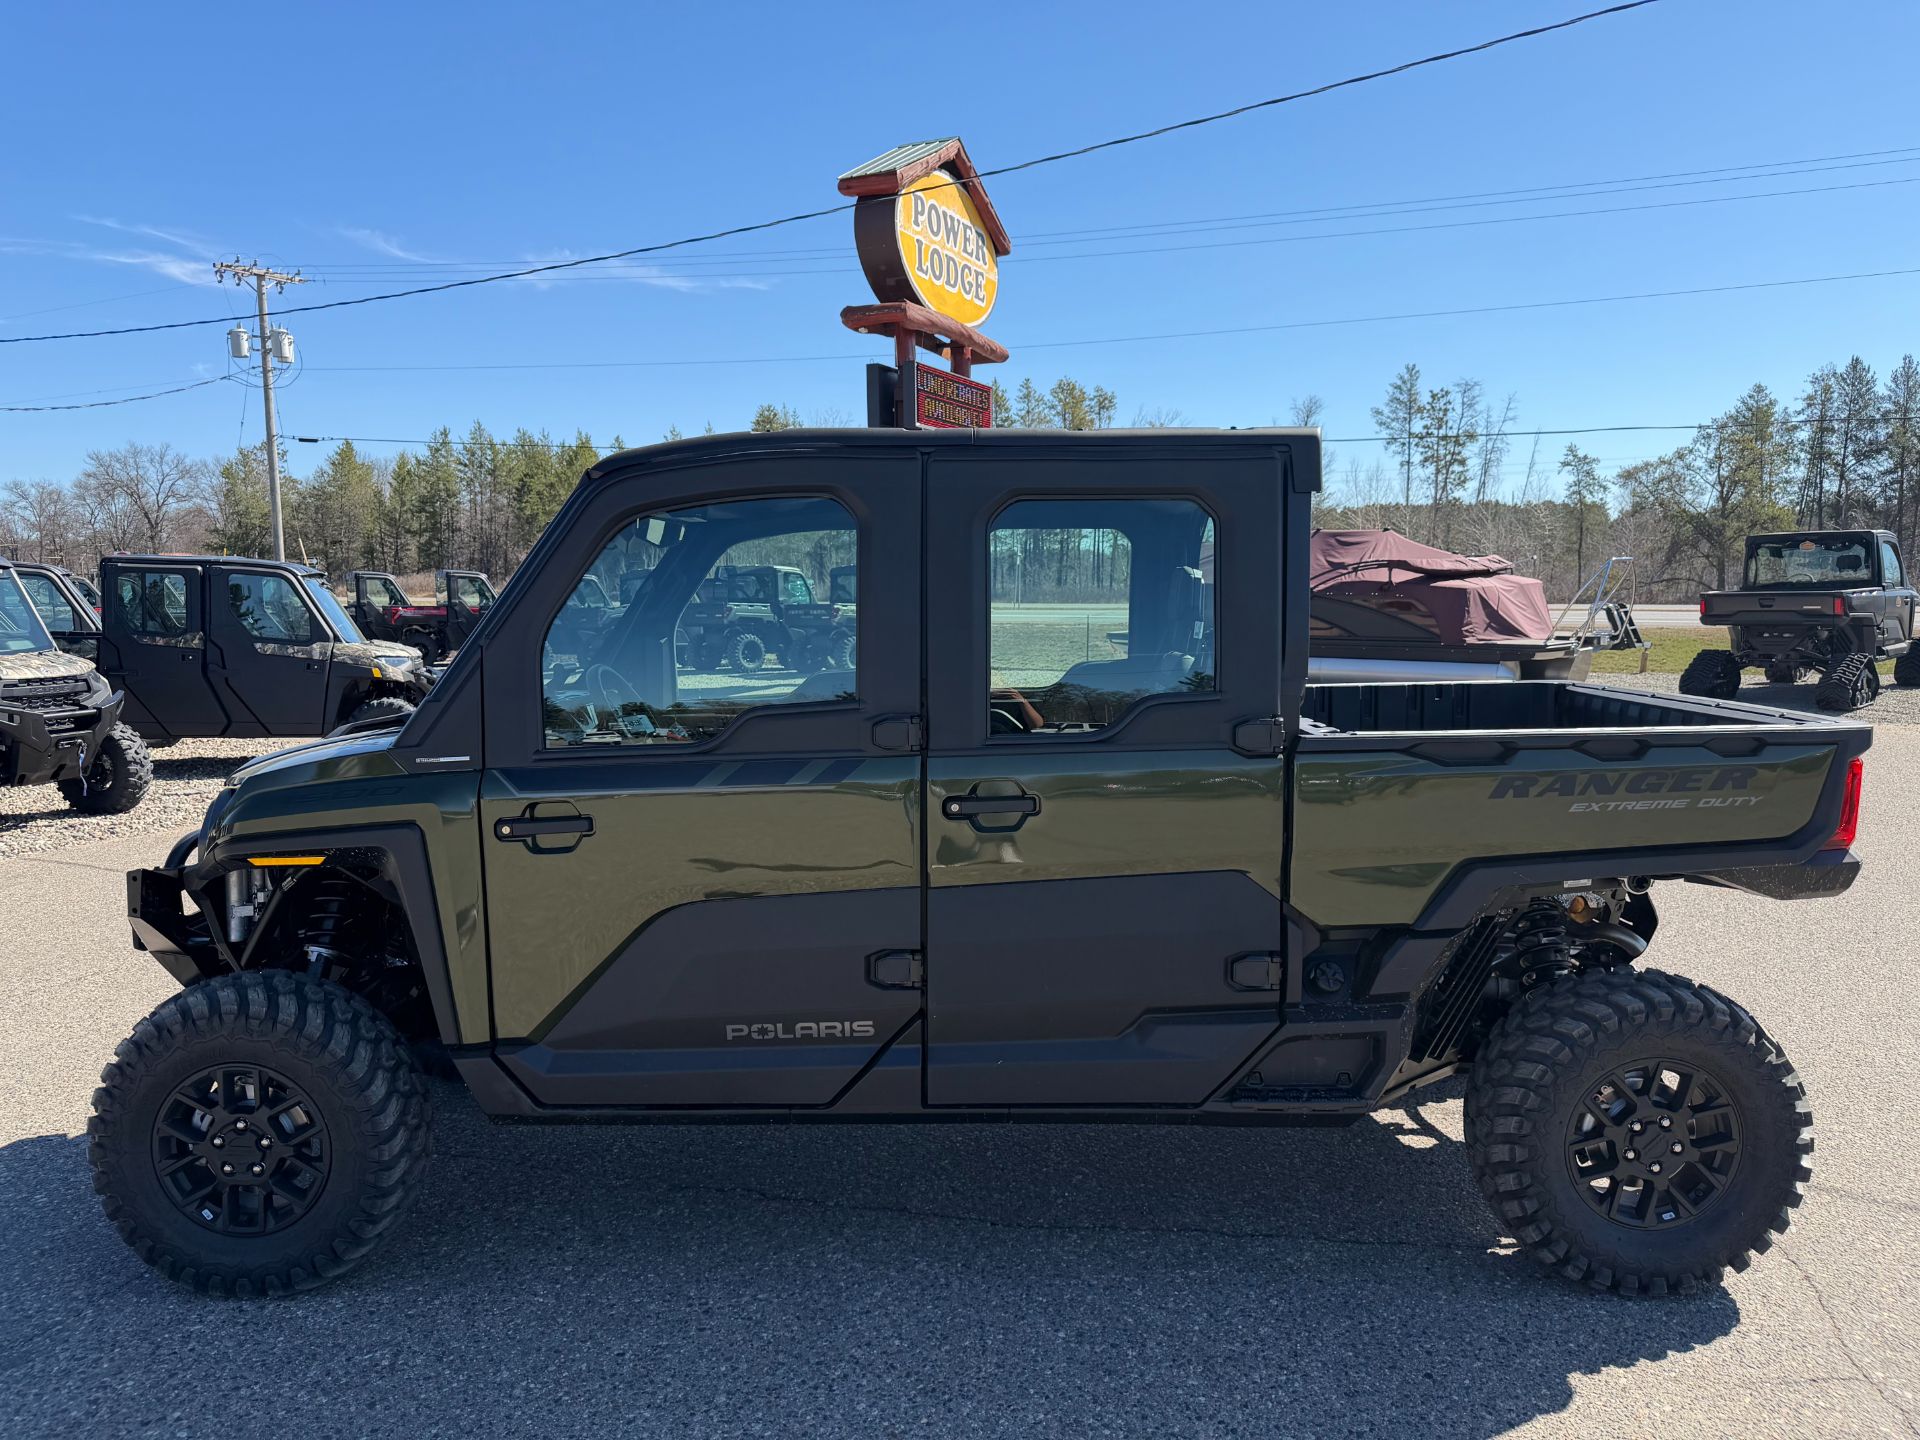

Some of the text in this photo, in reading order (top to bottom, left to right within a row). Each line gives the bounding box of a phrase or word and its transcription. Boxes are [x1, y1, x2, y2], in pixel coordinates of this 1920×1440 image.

[912, 192, 988, 267] POWER
[915, 238, 986, 306] LODGE
[946, 379, 989, 409] REBATES
[1488, 766, 1759, 799] RANGER
[1568, 796, 1764, 813] EXTREME DUTY
[725, 1020, 875, 1041] POLARIS
